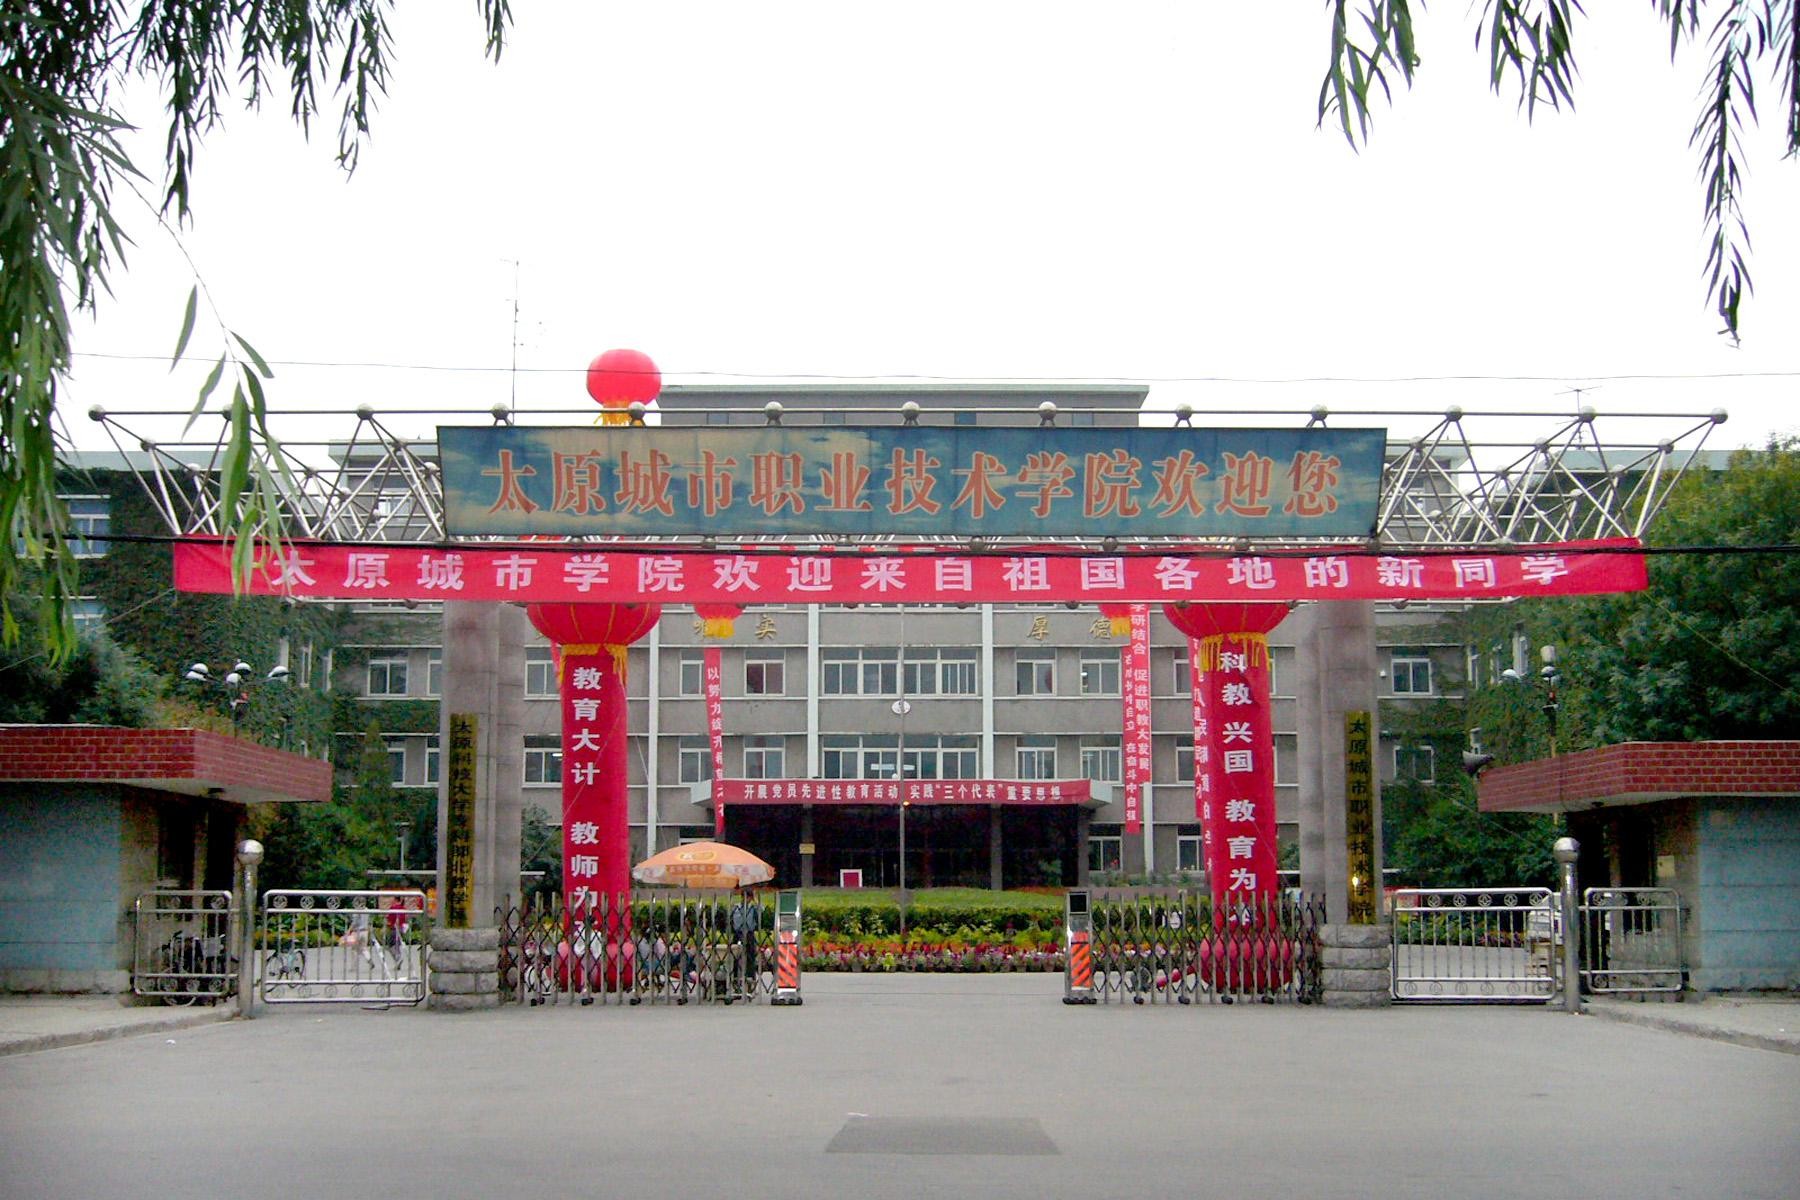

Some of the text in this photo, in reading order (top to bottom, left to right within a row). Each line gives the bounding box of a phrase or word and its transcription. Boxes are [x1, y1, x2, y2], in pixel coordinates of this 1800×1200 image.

[481, 448, 1342, 518] 太原城市职业技术学院欢迎您
[271, 551, 1569, 593] 太原城市学院欢迎来自祖国各地的新同学
[571, 666, 603, 786] 教育大计
[1220, 651, 1254, 774] 科教兴国
